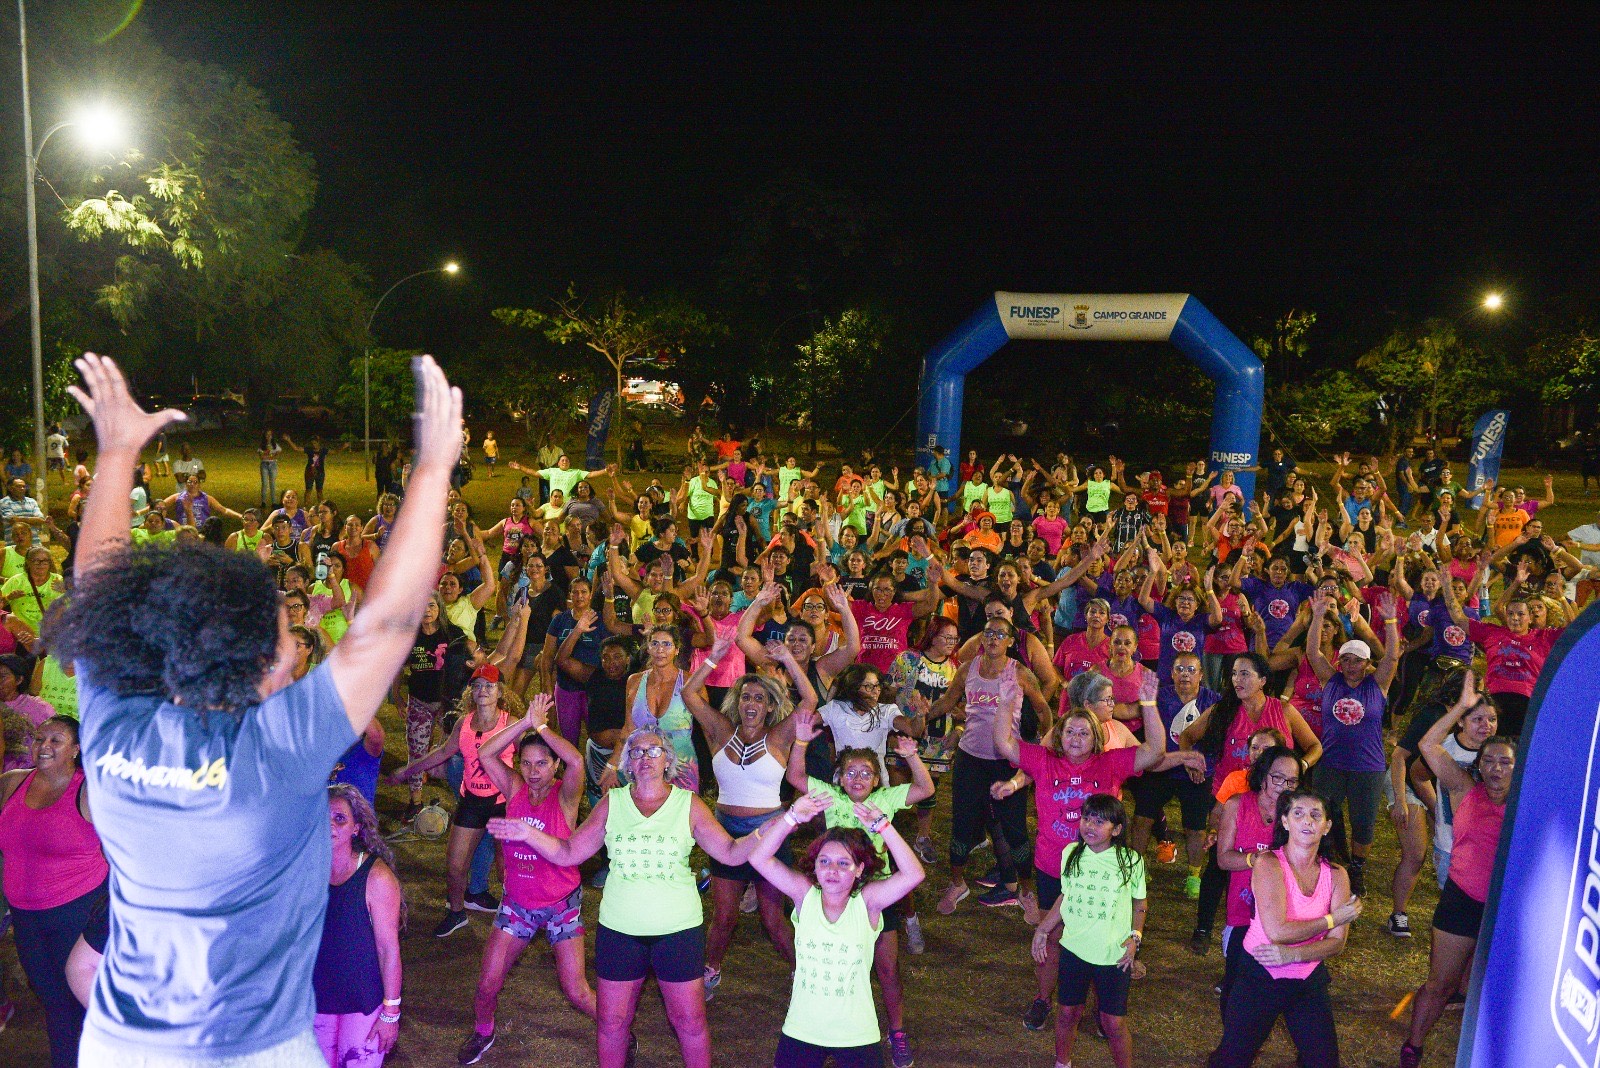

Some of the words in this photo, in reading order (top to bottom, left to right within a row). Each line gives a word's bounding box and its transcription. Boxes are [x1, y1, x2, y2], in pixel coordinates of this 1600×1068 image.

[1010, 306, 1060, 319] FUNESP
[1093, 311, 1127, 320] CAMPO
[1128, 311, 1167, 320] GRANDE
[589, 391, 611, 437] FUNESP
[1470, 412, 1506, 467] FUNESP
[1211, 451, 1252, 464] FUNESP
[471, 782, 492, 790] HARD!
